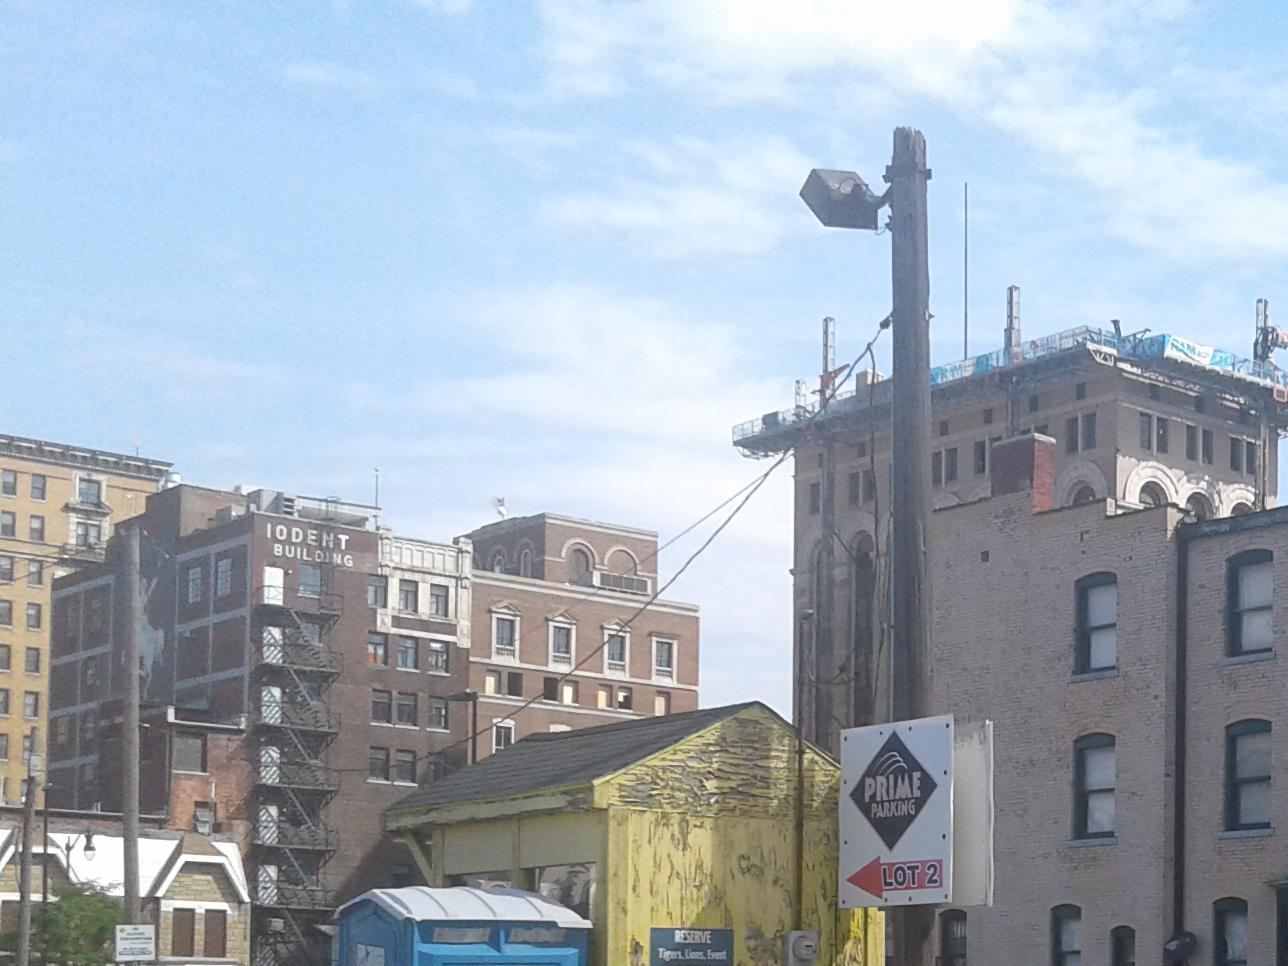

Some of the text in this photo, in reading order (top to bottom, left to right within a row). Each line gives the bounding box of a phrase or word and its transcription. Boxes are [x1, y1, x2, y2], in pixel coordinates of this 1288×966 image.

[266, 523, 350, 550] IODENT
[273, 543, 354, 567] BUILDING
[864, 771, 922, 802] PRIME
[871, 799, 916, 819] PARKING
[882, 861, 940, 889] LOT 2
[674, 930, 712, 944] RESERVE
[707, 949, 727, 960] Event
